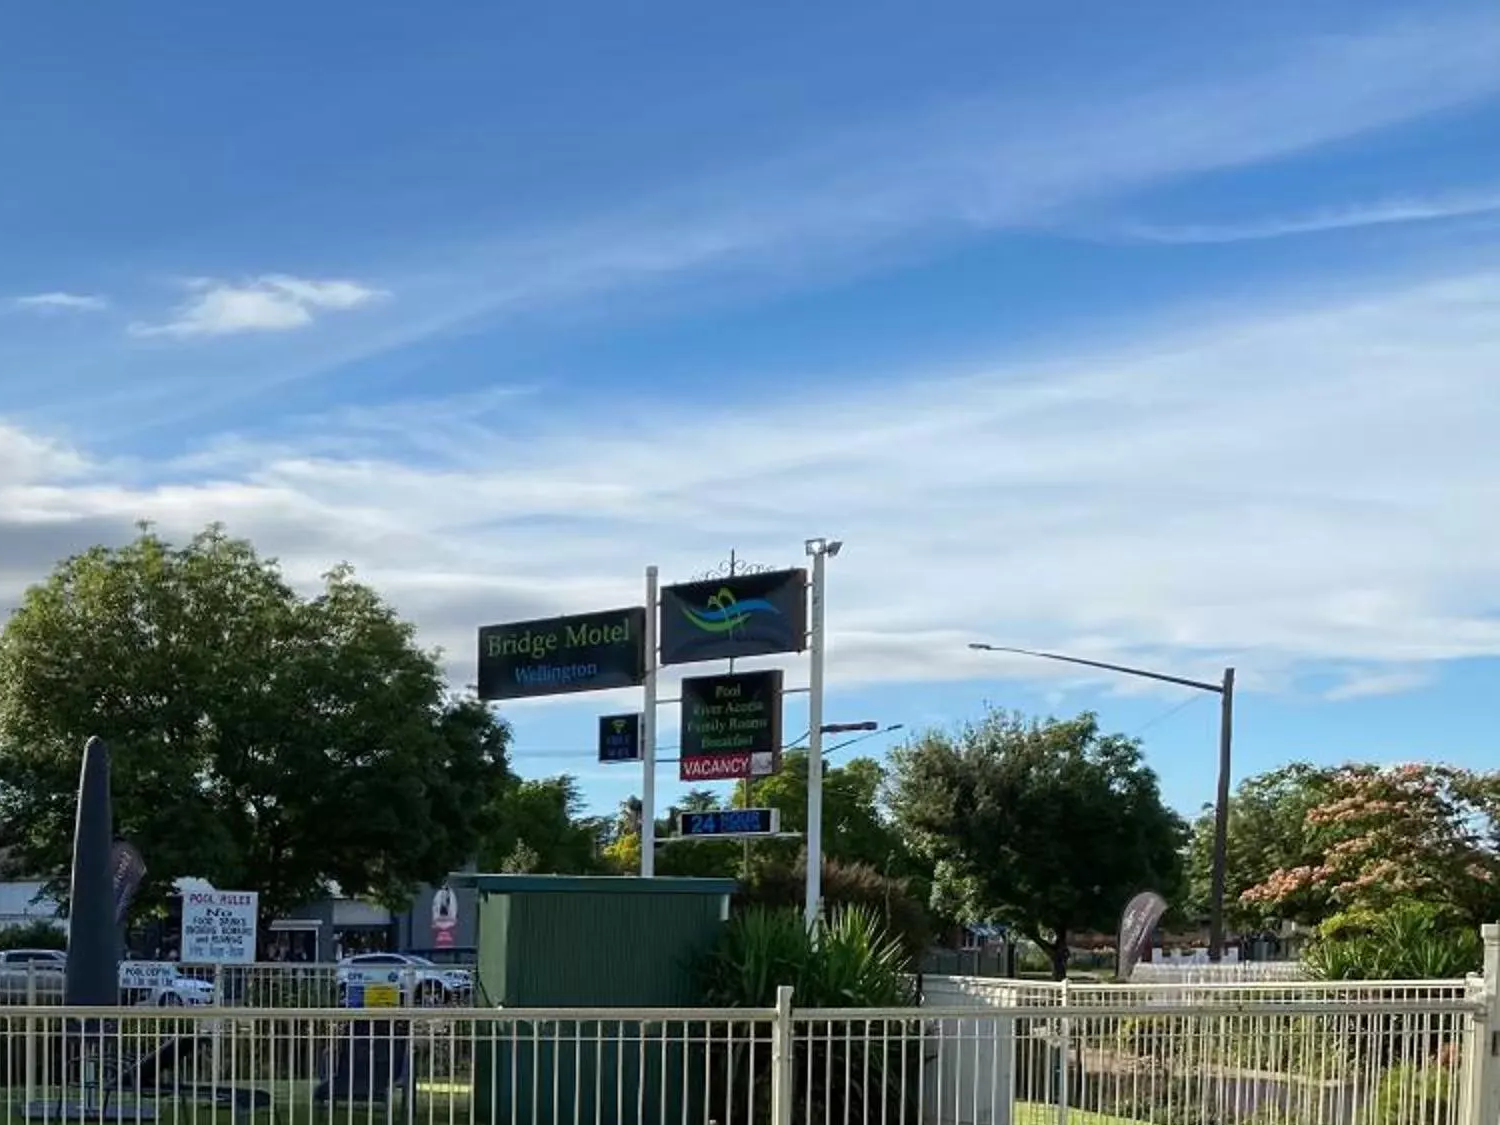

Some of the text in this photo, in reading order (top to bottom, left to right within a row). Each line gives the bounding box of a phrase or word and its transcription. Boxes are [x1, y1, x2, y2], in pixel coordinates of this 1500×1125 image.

[487, 617, 630, 659] Bridge Motel
[515, 663, 598, 684] Wellington
[715, 683, 741, 698] Pool
[683, 756, 749, 776] VACANCY
[691, 813, 715, 833] 24
[189, 893, 251, 906] POOL RULES
[206, 907, 233, 917] No
[125, 967, 145, 977] POOL
